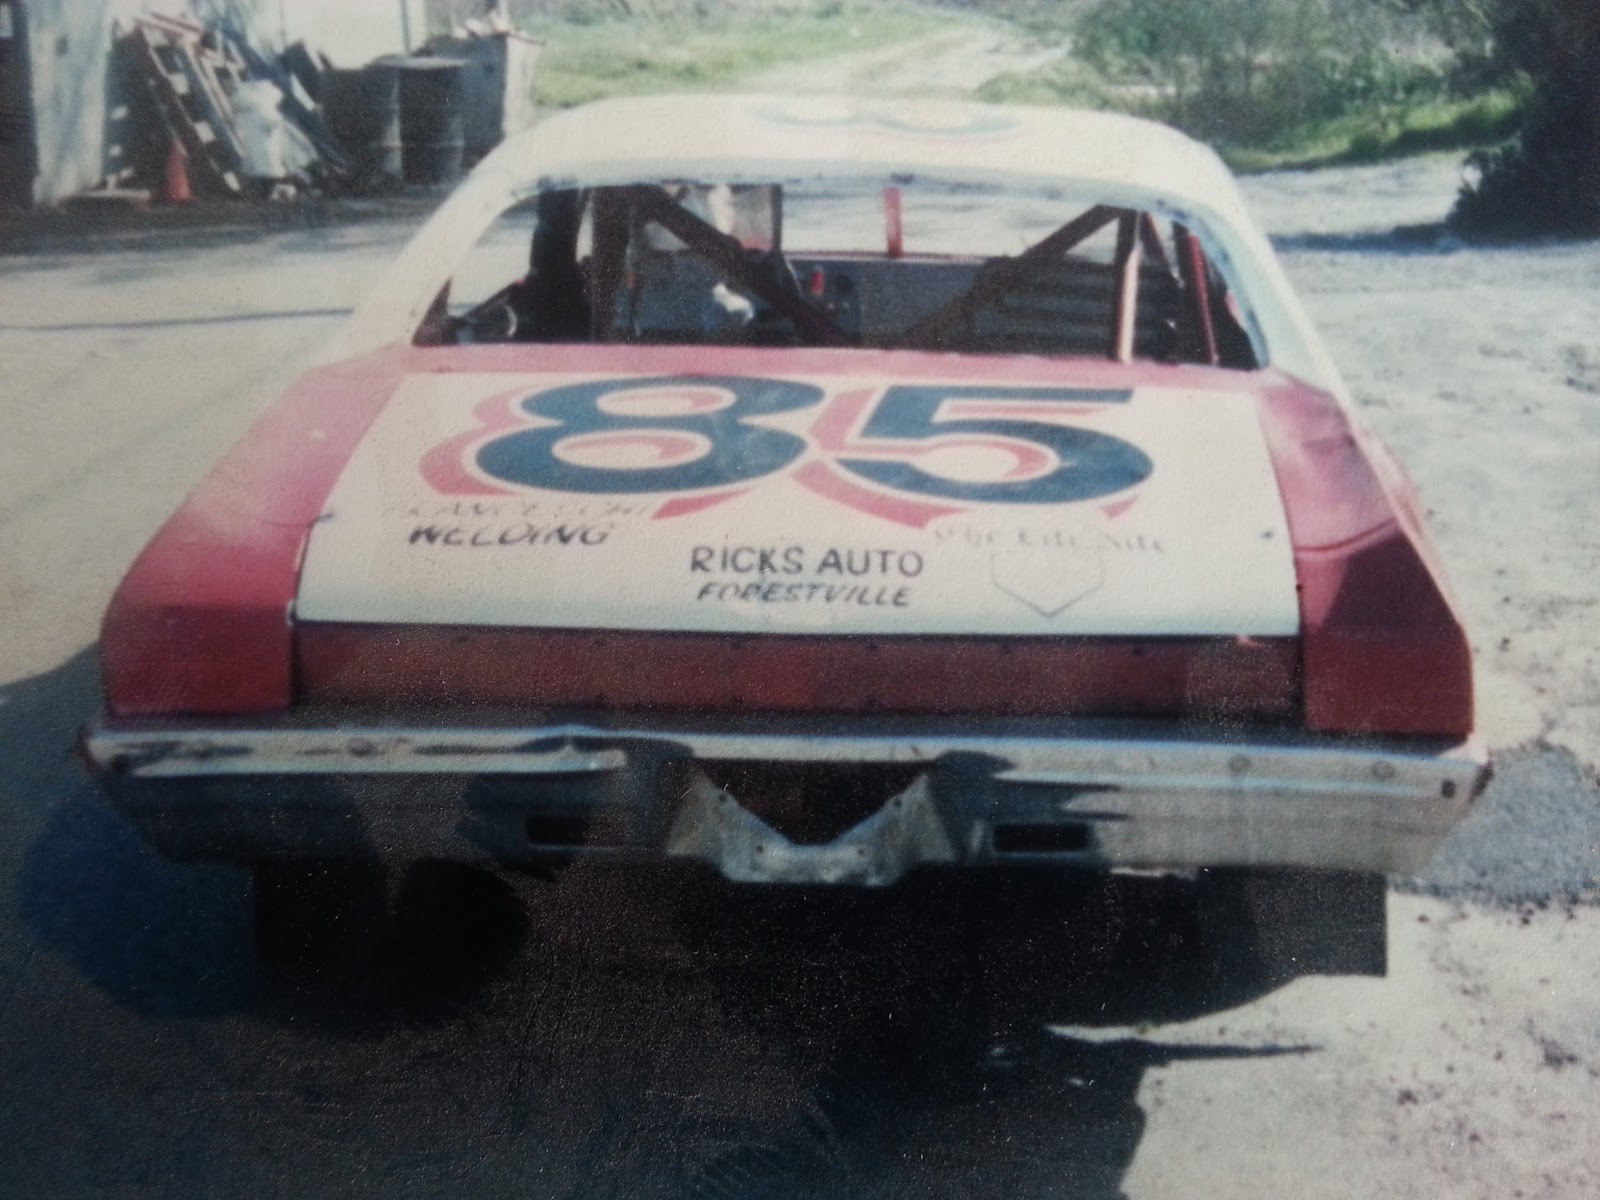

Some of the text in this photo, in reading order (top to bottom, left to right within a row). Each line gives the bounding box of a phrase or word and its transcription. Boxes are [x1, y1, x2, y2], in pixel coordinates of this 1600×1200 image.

[474, 373, 1154, 504] 85
[690, 545, 925, 578] RICKS AUTO
